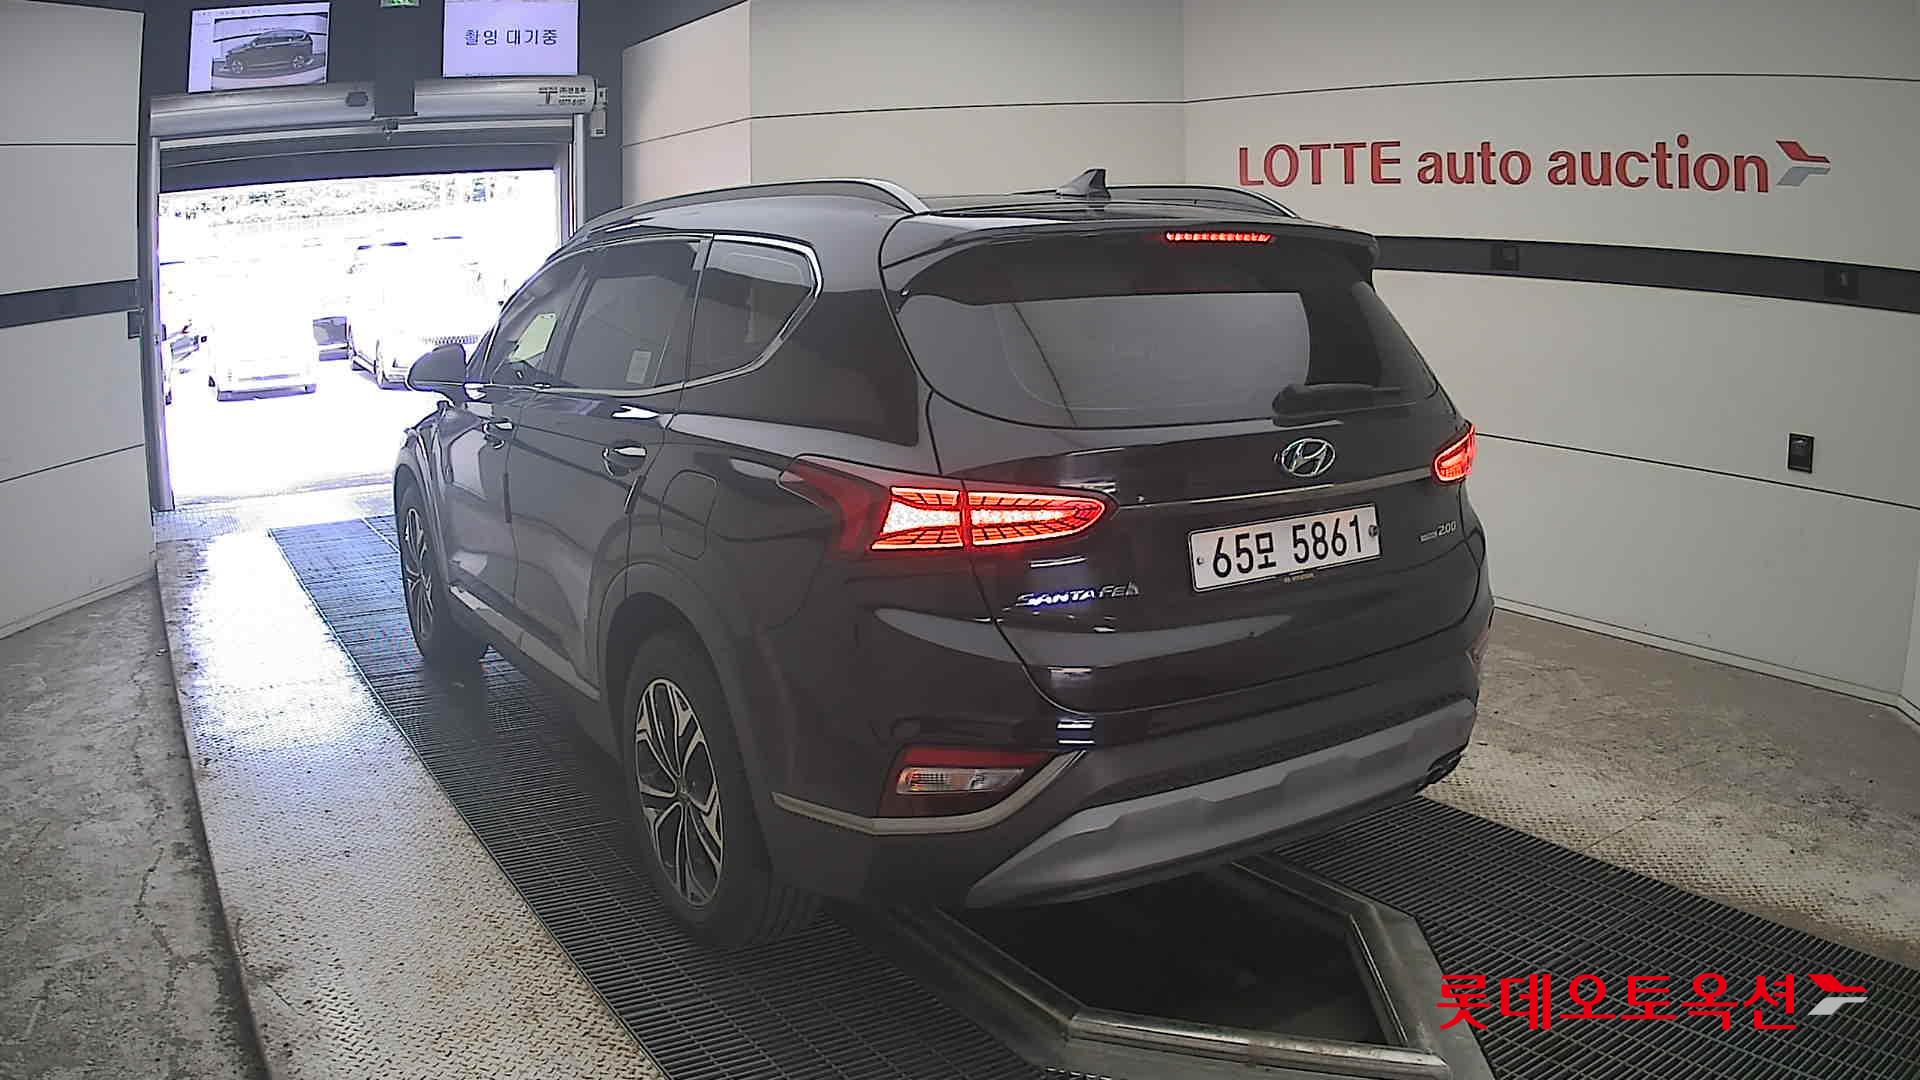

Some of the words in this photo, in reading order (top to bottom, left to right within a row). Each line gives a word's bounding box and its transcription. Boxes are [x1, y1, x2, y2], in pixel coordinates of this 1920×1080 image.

[506, 29, 558, 46] 대기중
[1238, 140, 1401, 187] LOTTE
[1416, 141, 1532, 185] auto
[1547, 134, 1769, 193] auction
[1212, 531, 1277, 578] 65모
[1291, 514, 1362, 564] 5861
